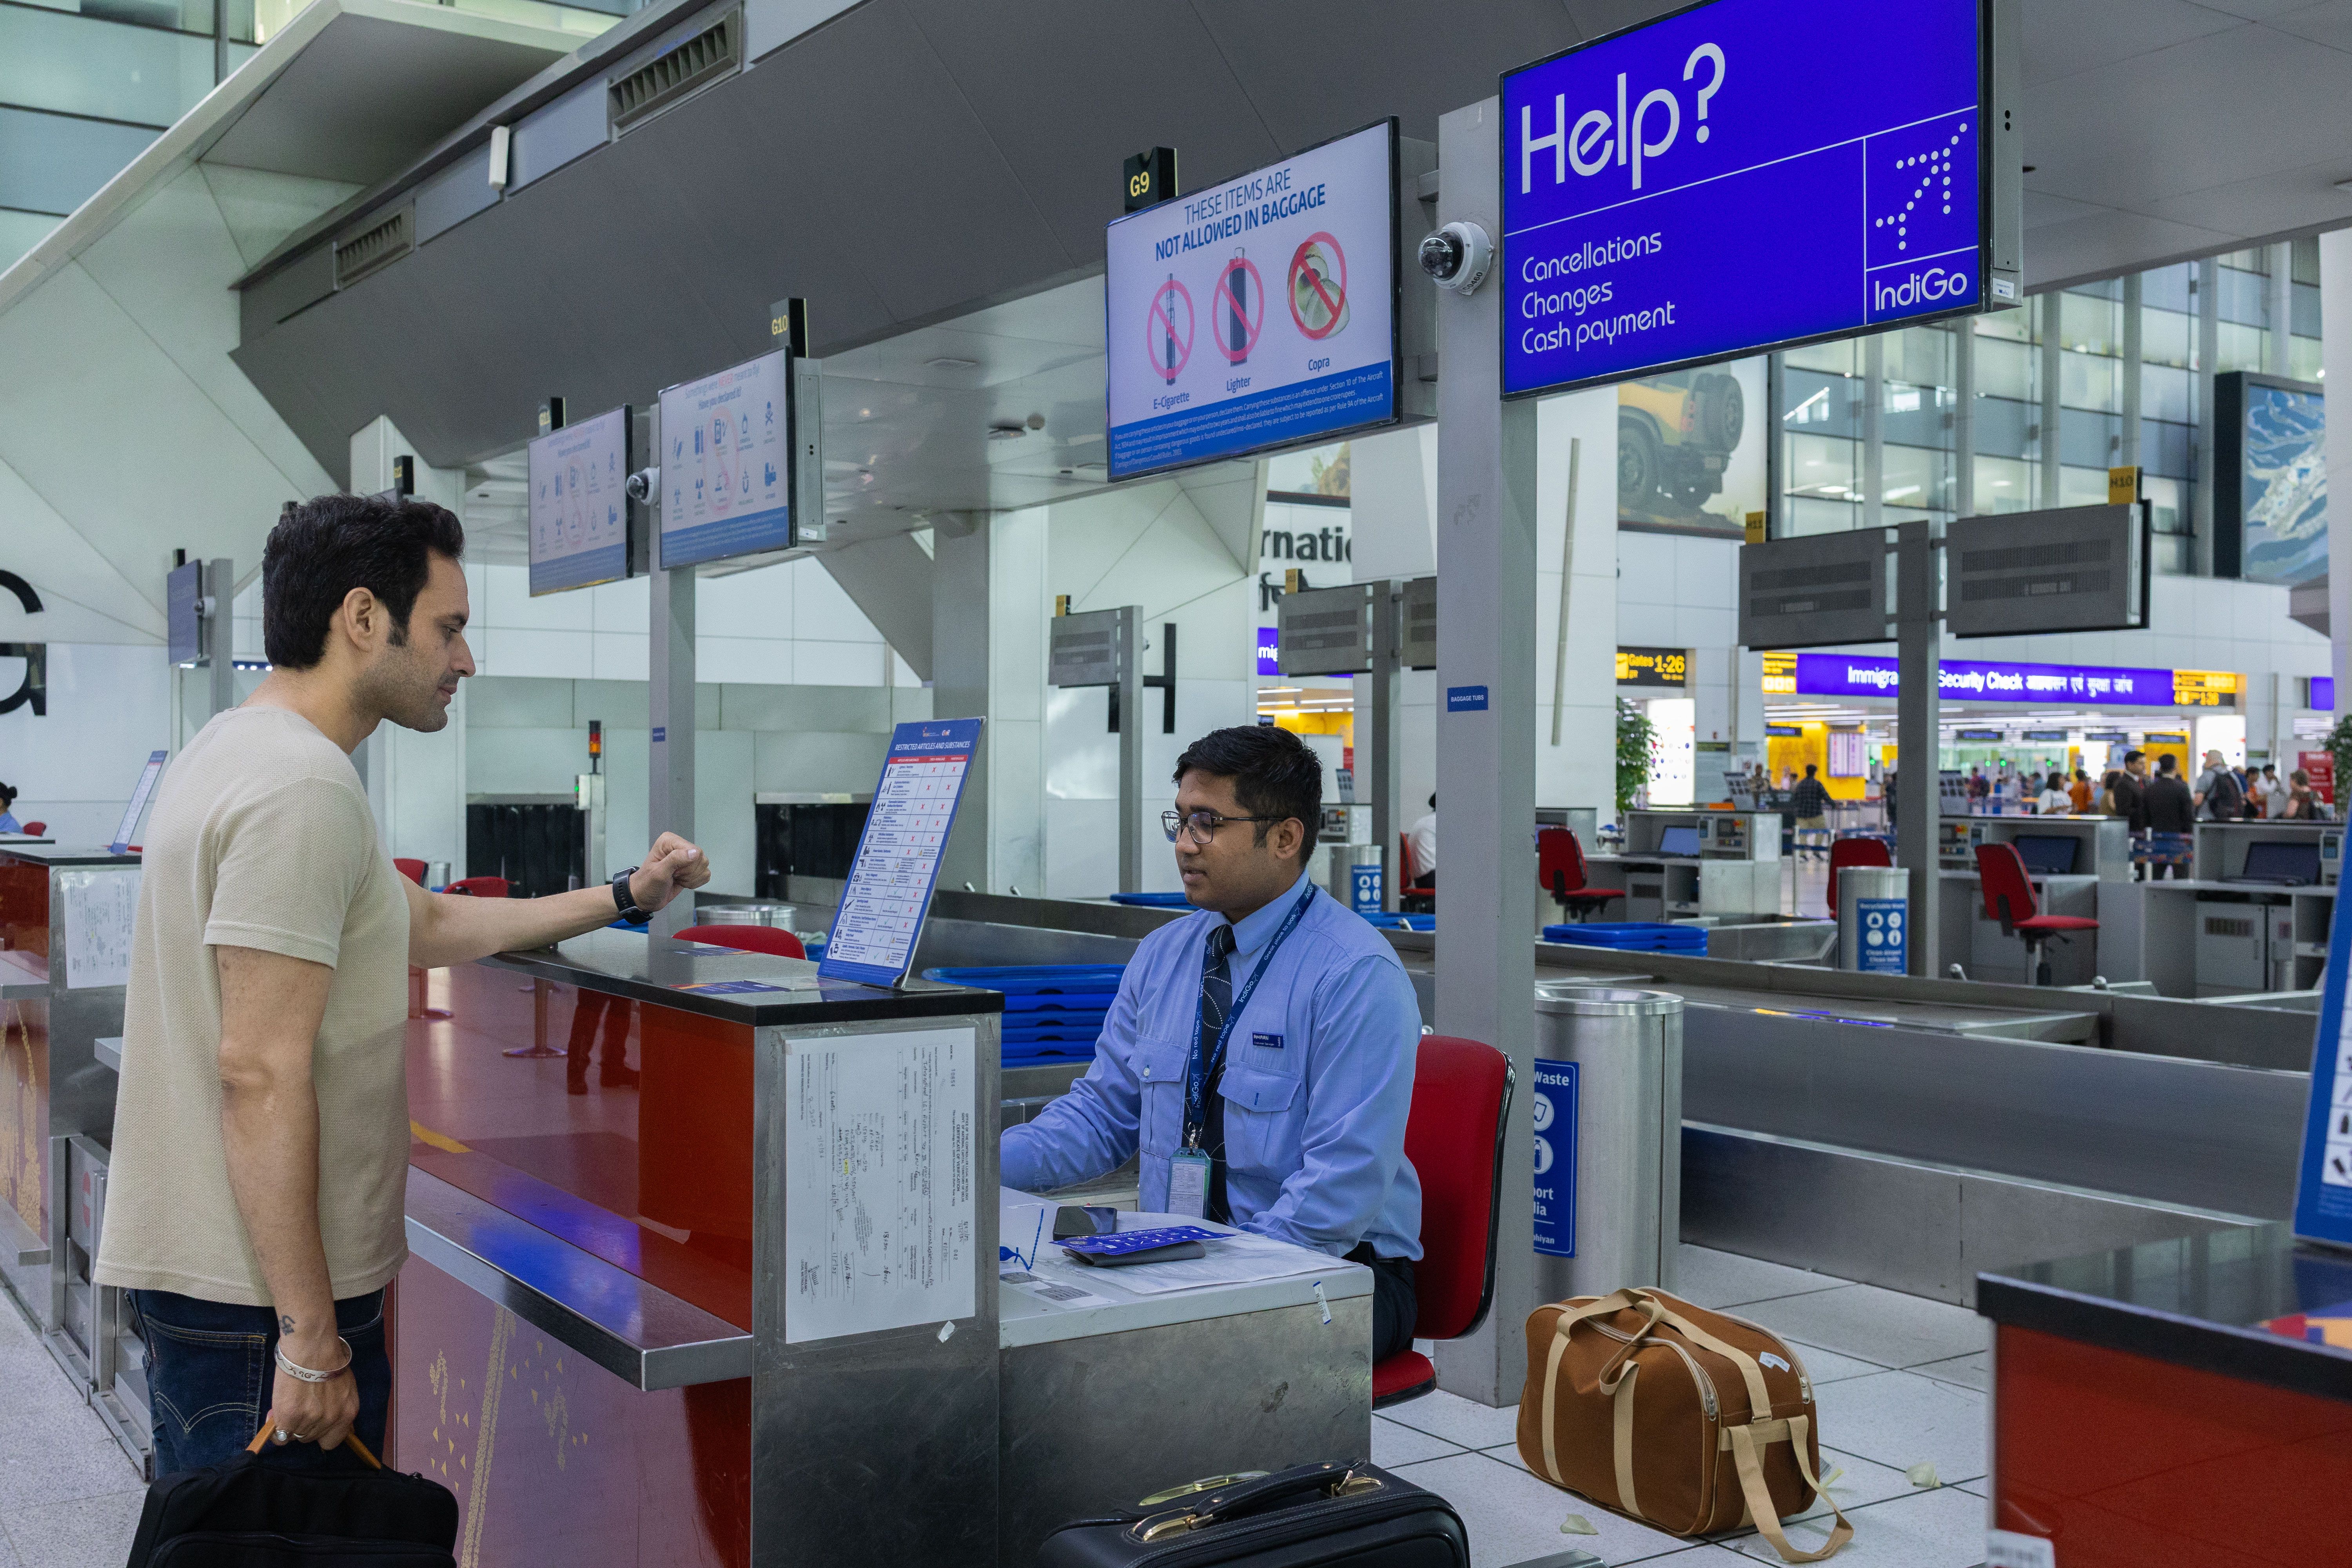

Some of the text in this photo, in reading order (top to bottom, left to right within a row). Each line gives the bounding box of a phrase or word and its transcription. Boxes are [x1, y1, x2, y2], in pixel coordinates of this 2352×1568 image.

[1521, 43, 1725, 194] Help?
[1130, 172, 1150, 197] G9
[1185, 169, 1291, 224] THESE ITEMS ARE
[1156, 183, 1325, 261] NOT ALLOWED IN BAGGAGE
[1522, 233, 1661, 283] Cancellations
[1522, 282, 1613, 319] Changes
[1875, 268, 1967, 311] IndiGo
[771, 315, 788, 335] G10
[1522, 301, 1675, 354] Cash payment
[1308, 358, 1330, 372] Copra
[1227, 377, 1251, 393] Lighter
[1316, 384, 1328, 393] under
[1330, 380, 1345, 390] Section
[1367, 371, 1383, 381] Aircraft
[1154, 392, 1190, 410] E-Cigarette
[1306, 407, 1323, 419] reported
[1337, 401, 1346, 410] Rule
[1347, 400, 1353, 408] 9A
[1354, 399, 1359, 407] of
[1367, 393, 1383, 404] Aircraft
[1655, 655, 1684, 673] 1-26
[1847, 666, 1899, 688] Immigra
[1987, 671, 2023, 690] Check
[1264, 946, 1275, 960] Great
[1274, 931, 1284, 945] place
[1287, 913, 1297, 925] work
[1238, 981, 1254, 1003] IndiGo
[1192, 1049, 1198, 1059] No
[1211, 1053, 1216, 1063] No
[1220, 1024, 1229, 1038] tape
[1534, 1071, 1569, 1086] Waste
